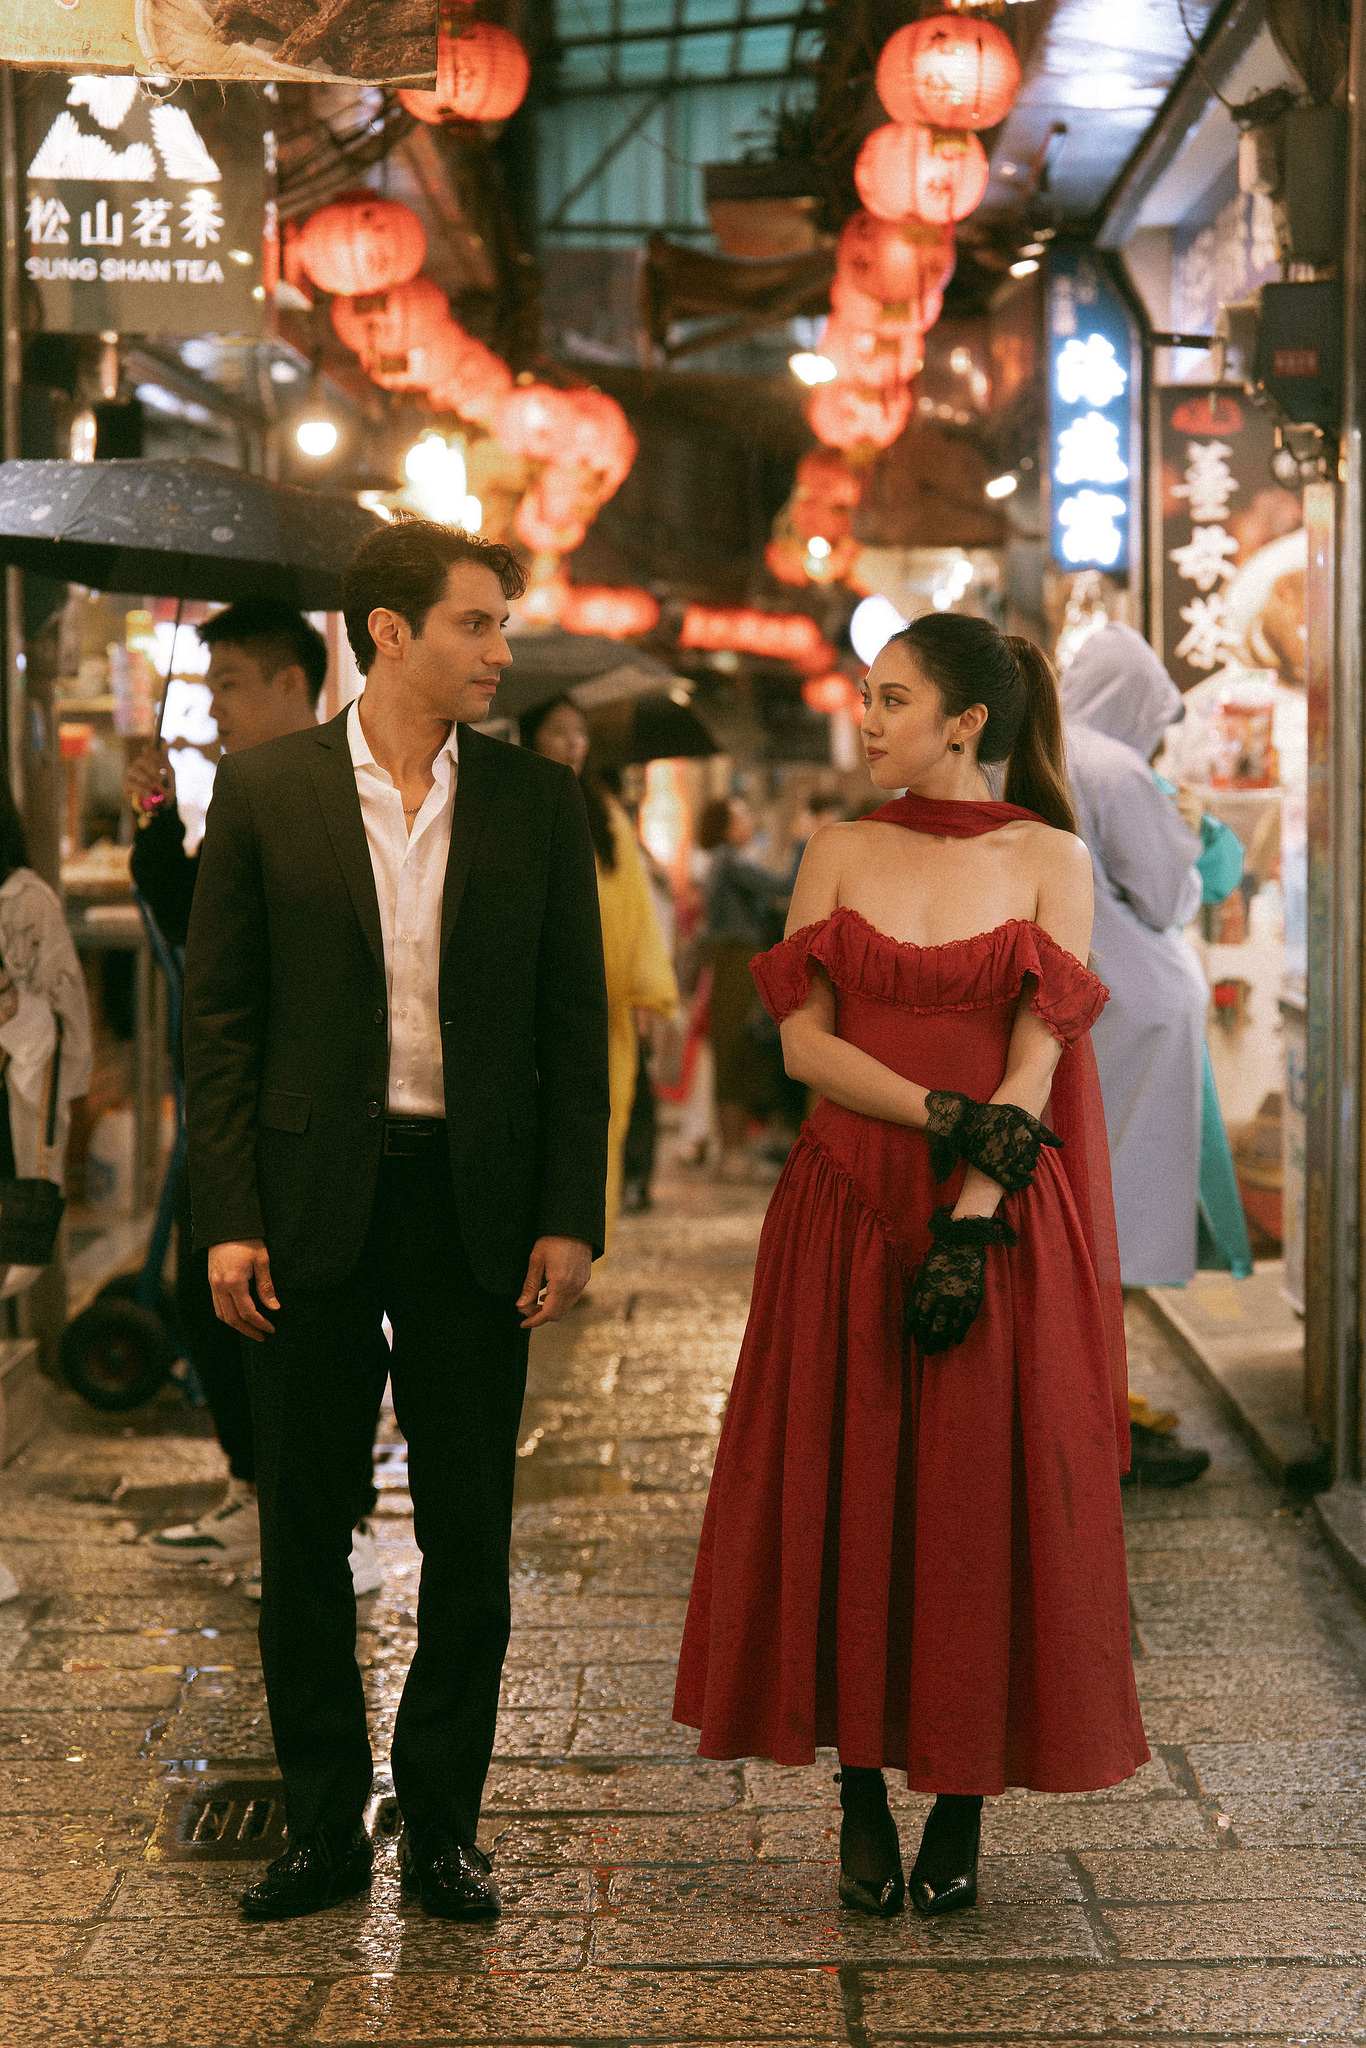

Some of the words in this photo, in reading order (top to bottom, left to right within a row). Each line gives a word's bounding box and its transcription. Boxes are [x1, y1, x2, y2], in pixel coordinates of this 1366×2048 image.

[25, 195, 225, 248] 松山茗茶
[25, 256, 98, 281] SUNG
[100, 258, 171, 282] SHAN
[172, 259, 225, 283] TEA
